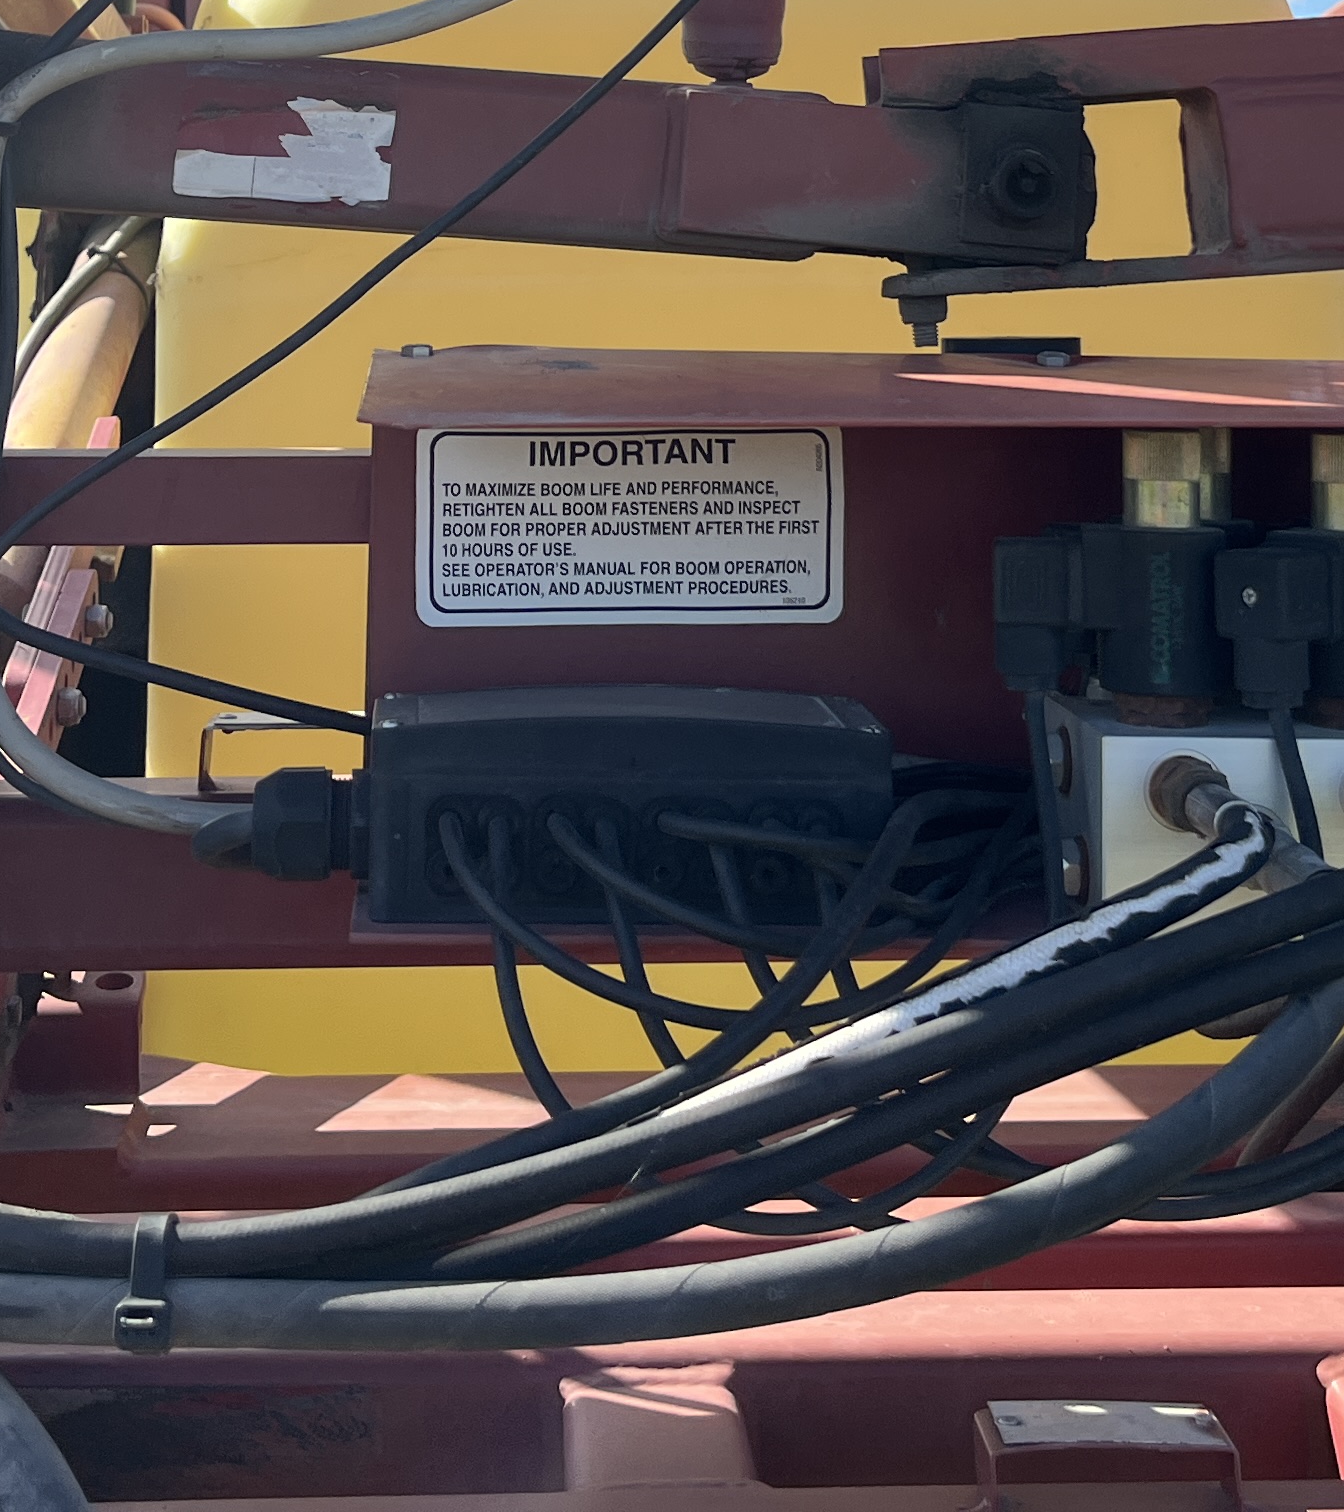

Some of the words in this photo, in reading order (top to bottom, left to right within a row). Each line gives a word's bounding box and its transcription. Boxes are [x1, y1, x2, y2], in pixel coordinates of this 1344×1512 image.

[529, 438, 737, 466] IMPORTANT
[441, 483, 463, 497] TO
[465, 483, 538, 497] MAXIMIZE
[540, 483, 587, 497] BOOM
[590, 482, 623, 496] LIFE
[625, 482, 659, 495] AND
[661, 481, 780, 497] PERFORMANCE,
[442, 503, 527, 517] RETIGHTEN
[528, 502, 560, 516] ALL
[561, 502, 609, 516] BOOM
[611, 501, 700, 515] FASTENERS
[702, 501, 736, 515] AND
[738, 500, 802, 515] INSPECT
[442, 523, 487, 537] BOOM
[490, 522, 522, 537] FOR
[525, 522, 588, 537] PROPER
[590, 521, 693, 536] ADJUSTMENT
[694, 521, 744, 535] AFTER
[745, 521, 776, 534] THE
[778, 520, 821, 534] FIRST
[441, 544, 459, 557] 10
[461, 543, 515, 557] HOURS
[517, 543, 540, 557] OF
[542, 542, 578, 556] USE.
[441, 563, 472, 577] SEE
[474, 562, 571, 577] OPERATOR'S
[572, 562, 637, 576] MANUAL
[640, 561, 674, 575] FOR
[675, 561, 721, 575] BOOM
[723, 560, 812, 578] OPERATION,
[442, 582, 546, 599] LUBRICATION,
[547, 581, 582, 595] AND
[583, 581, 686, 595] ADJUSTMENT
[687, 579, 793, 595] PROCEDURES.
